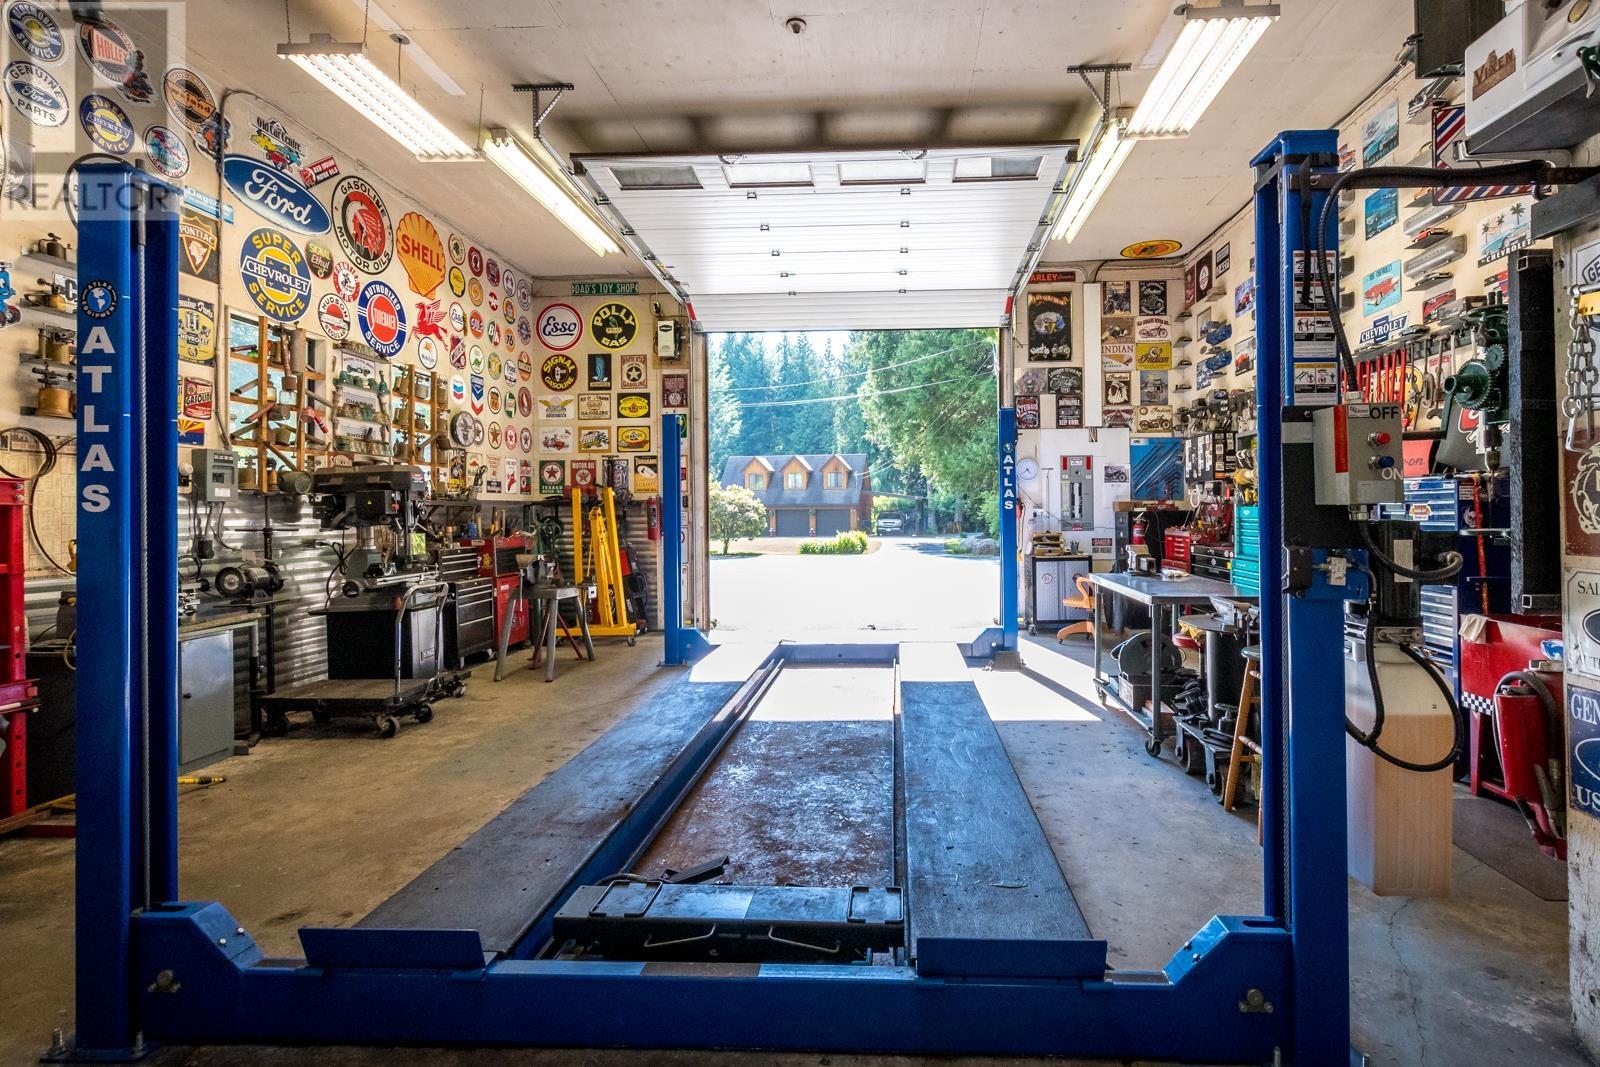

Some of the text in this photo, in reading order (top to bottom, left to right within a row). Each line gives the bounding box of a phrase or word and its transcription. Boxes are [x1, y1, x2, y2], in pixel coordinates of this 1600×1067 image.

[16, 32, 57, 58] SERVICE
[9, 63, 65, 99] GENUINE
[21, 86, 53, 106] Ford
[17, 99, 57, 122] PARTS
[91, 99, 125, 122] SUPER
[88, 113, 129, 137] CHEVROLET
[87, 125, 130, 152] SERVICE
[244, 169, 311, 225] Ford
[341, 180, 388, 218] GASOLINE
[180, 225, 214, 244] PONTIAC
[252, 235, 301, 265] SUPER
[336, 226, 390, 271] MOTOR OILS
[401, 234, 443, 272] SHELL
[1486, 239, 1532, 263] CHEVROLET
[246, 260, 309, 292] CHEVROLET
[1030, 273, 1058, 281] ARLEY
[249, 282, 305, 317] SERVICE
[365, 284, 401, 311] AUTHORIZED
[575, 283, 635, 294] DAD'S TOY SHOP
[321, 296, 348, 318] HUDSON
[593, 305, 635, 327] POLLY
[324, 324, 347, 339] REGULAR
[543, 316, 577, 336] Esso
[1361, 317, 1404, 342] CHEVROLET
[365, 331, 401, 354] SERVICE
[601, 336, 628, 347] GAS
[1101, 345, 1134, 353] INDIAN
[543, 355, 576, 373] SIGNAL
[1138, 354, 1169, 364] Indian
[544, 376, 575, 389] GASOLINE
[81, 326, 116, 513] ATLAS
[1370, 406, 1399, 419] OFF
[1003, 455, 1016, 510] ATLAS
[1381, 467, 1403, 481] ON
